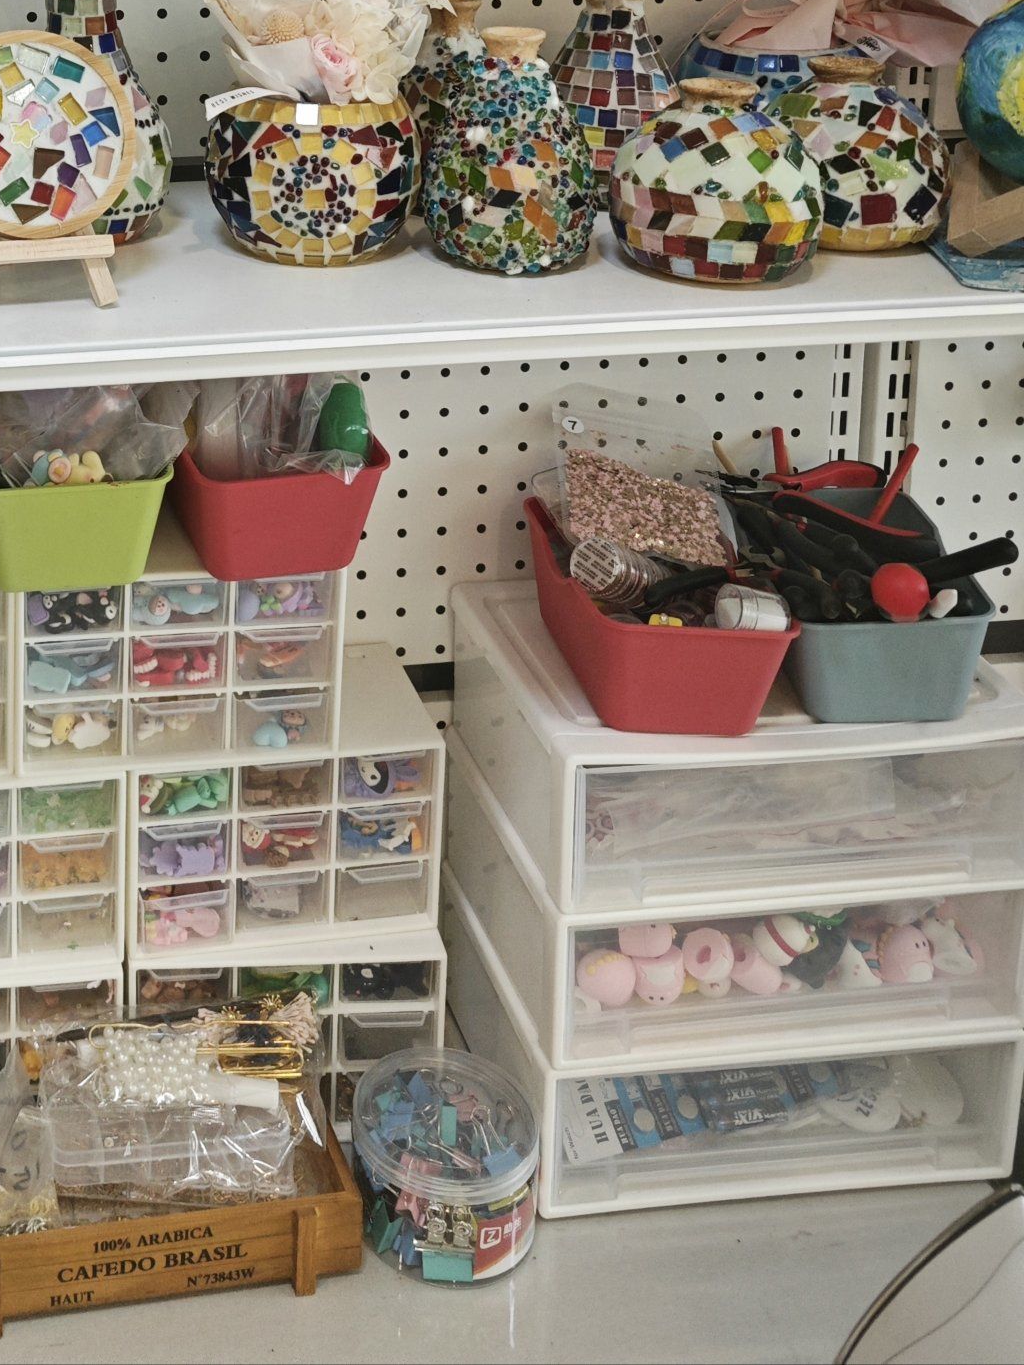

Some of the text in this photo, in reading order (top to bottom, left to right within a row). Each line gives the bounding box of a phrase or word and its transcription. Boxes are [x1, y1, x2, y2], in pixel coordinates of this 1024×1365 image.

[568, 420, 577, 430] 7
[586, 1108, 609, 1144] HUA
[93, 1226, 213, 1253] 100% ARABICA
[57, 1243, 248, 1283] CAFEDO BRASIL
[50, 1290, 95, 1306] HAUT
